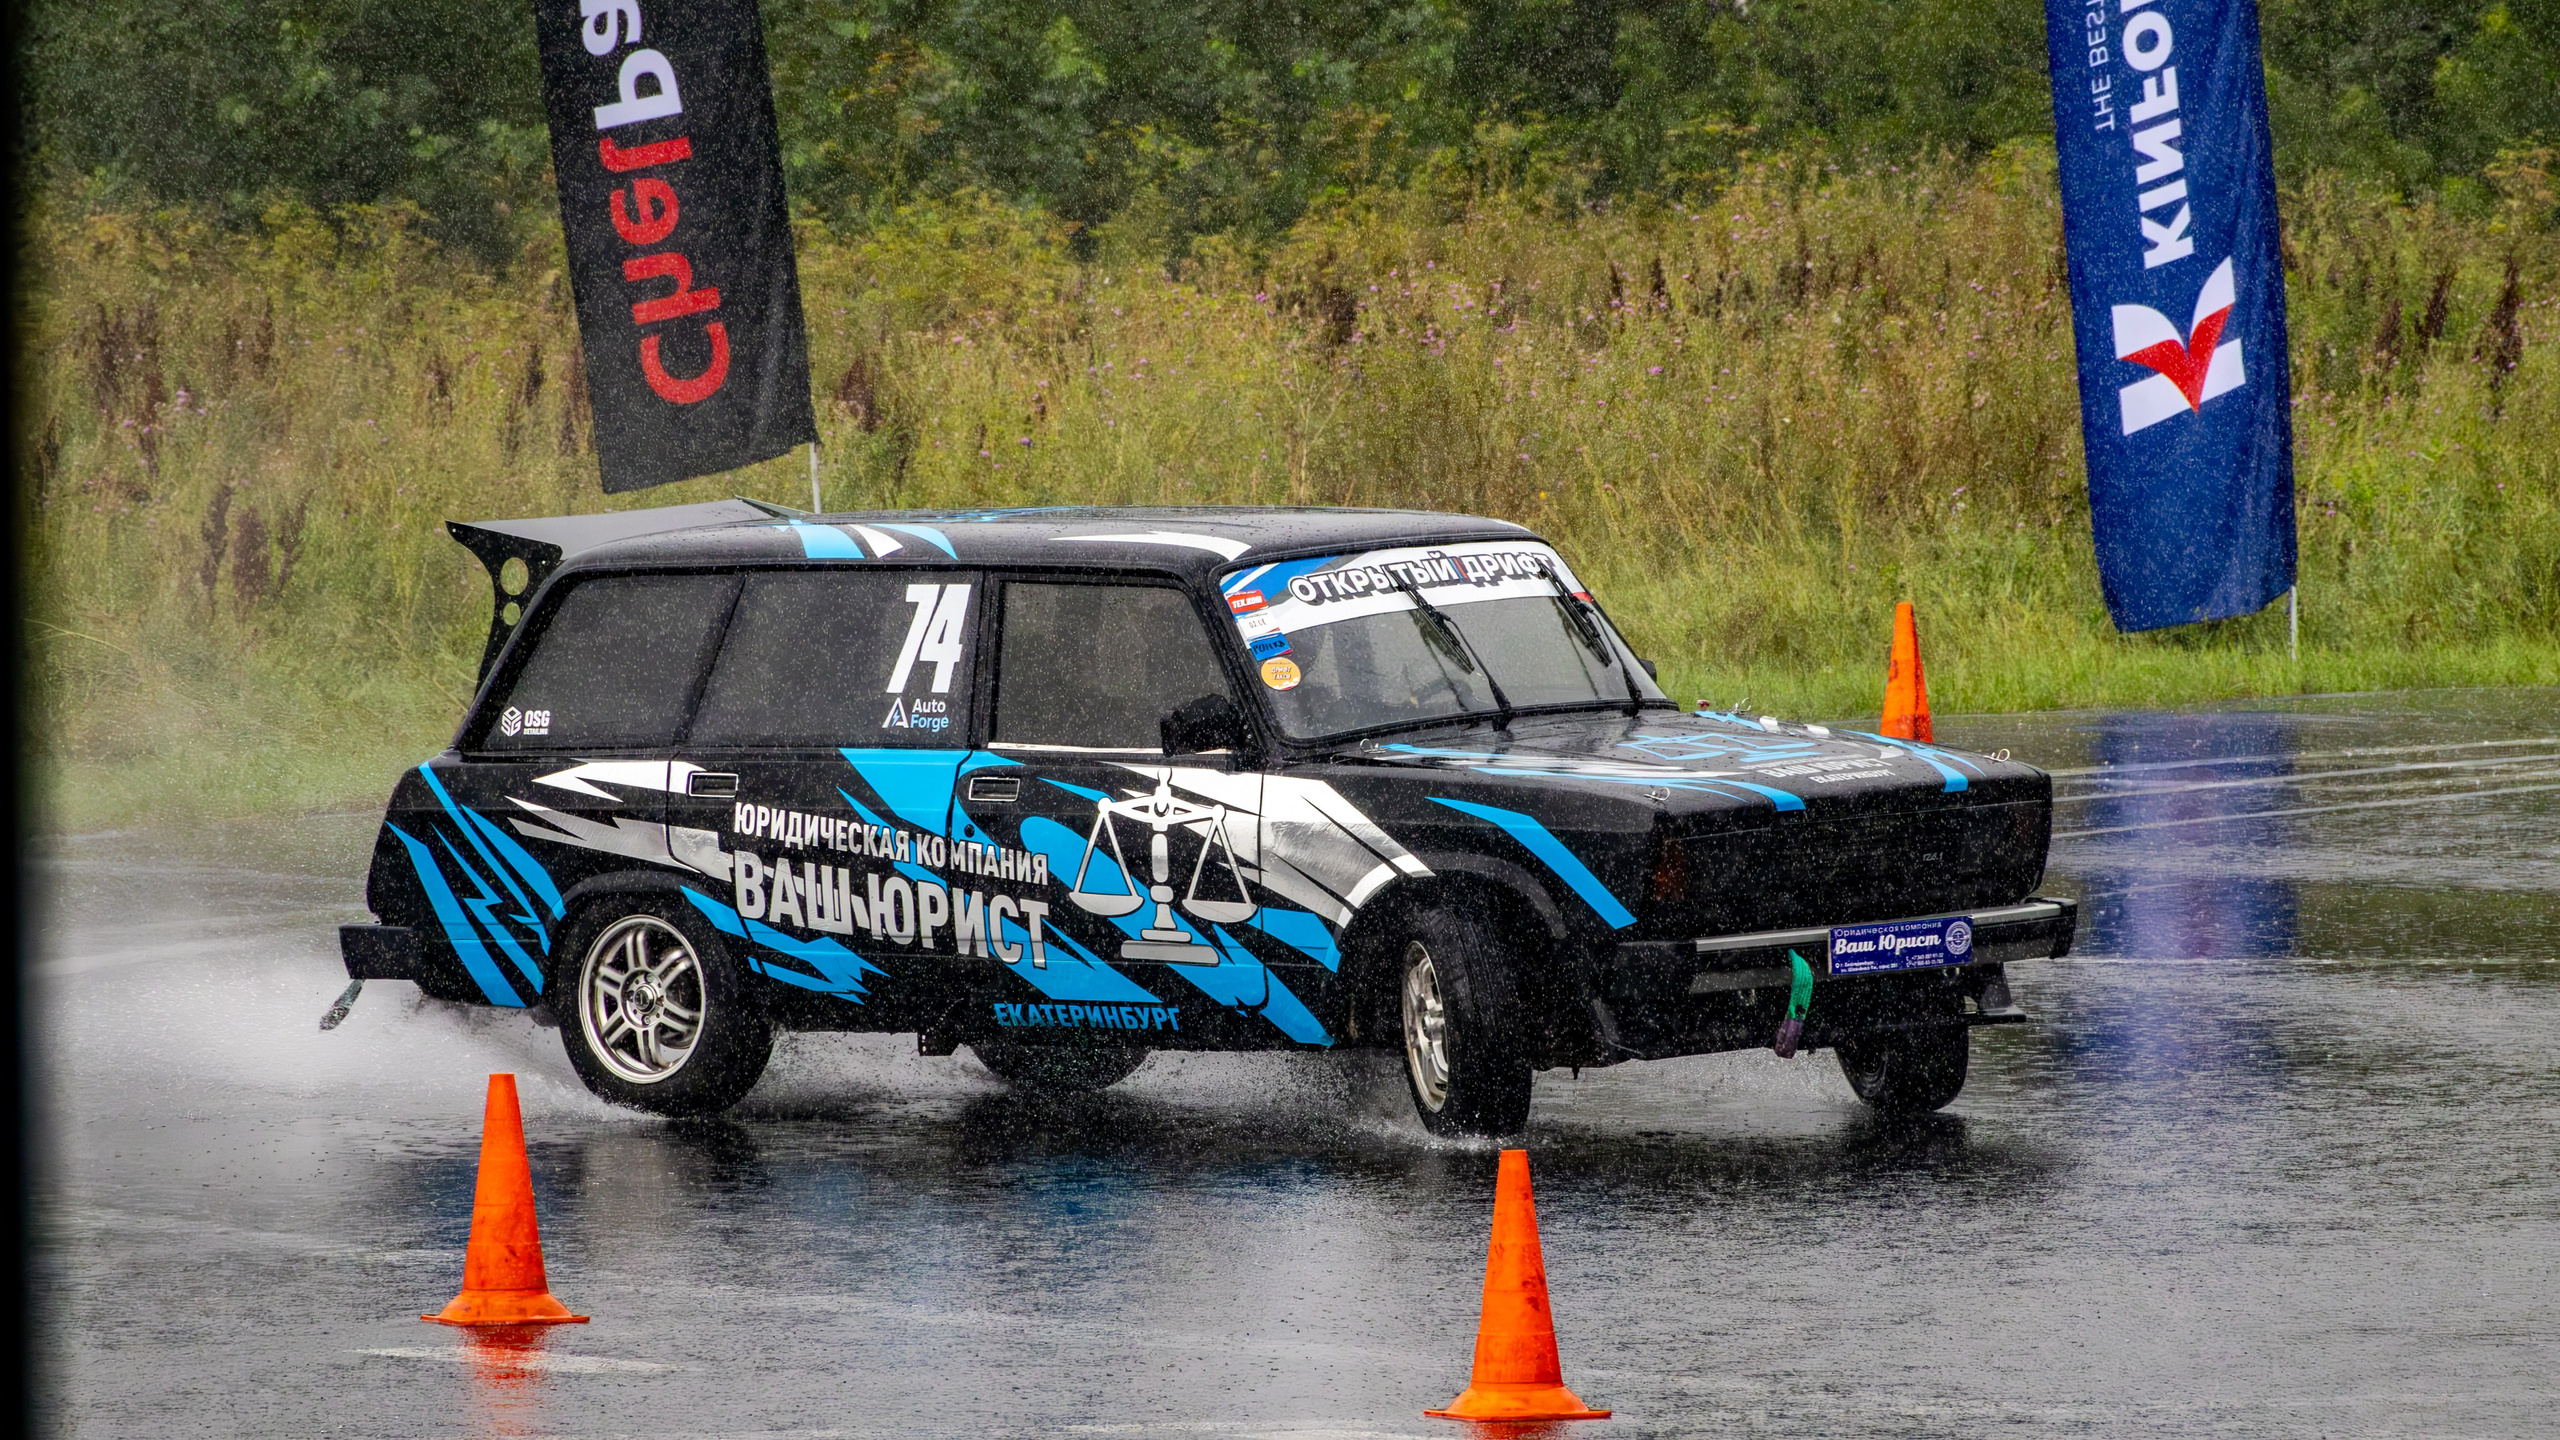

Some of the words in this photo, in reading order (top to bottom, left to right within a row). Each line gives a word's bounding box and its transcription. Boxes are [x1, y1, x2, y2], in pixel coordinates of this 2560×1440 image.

[1288, 551, 1458, 606] ОТКРЫТЫЙ
[1459, 552, 1556, 588] ДРИФТ
[886, 584, 971, 693] 74
[1271, 666, 1292, 674] ДРИФТ
[912, 698, 947, 713] Auto
[524, 710, 551, 727] OSG
[910, 714, 950, 733] Forge
[734, 802, 911, 864] ЮРИДИЧЕСКАЯ
[915, 832, 1049, 886] КОМПАНИЯ
[734, 849, 854, 936] ВАШ
[867, 872, 1050, 970] ЮРИСТ
[1834, 926, 1899, 938] Юридическая
[1901, 921, 1942, 932] компания
[1833, 938, 1876, 955] Ваш
[1878, 933, 1942, 956] Юрист
[993, 1002, 1180, 1031] ЕКАТЕРИНБУРГ
